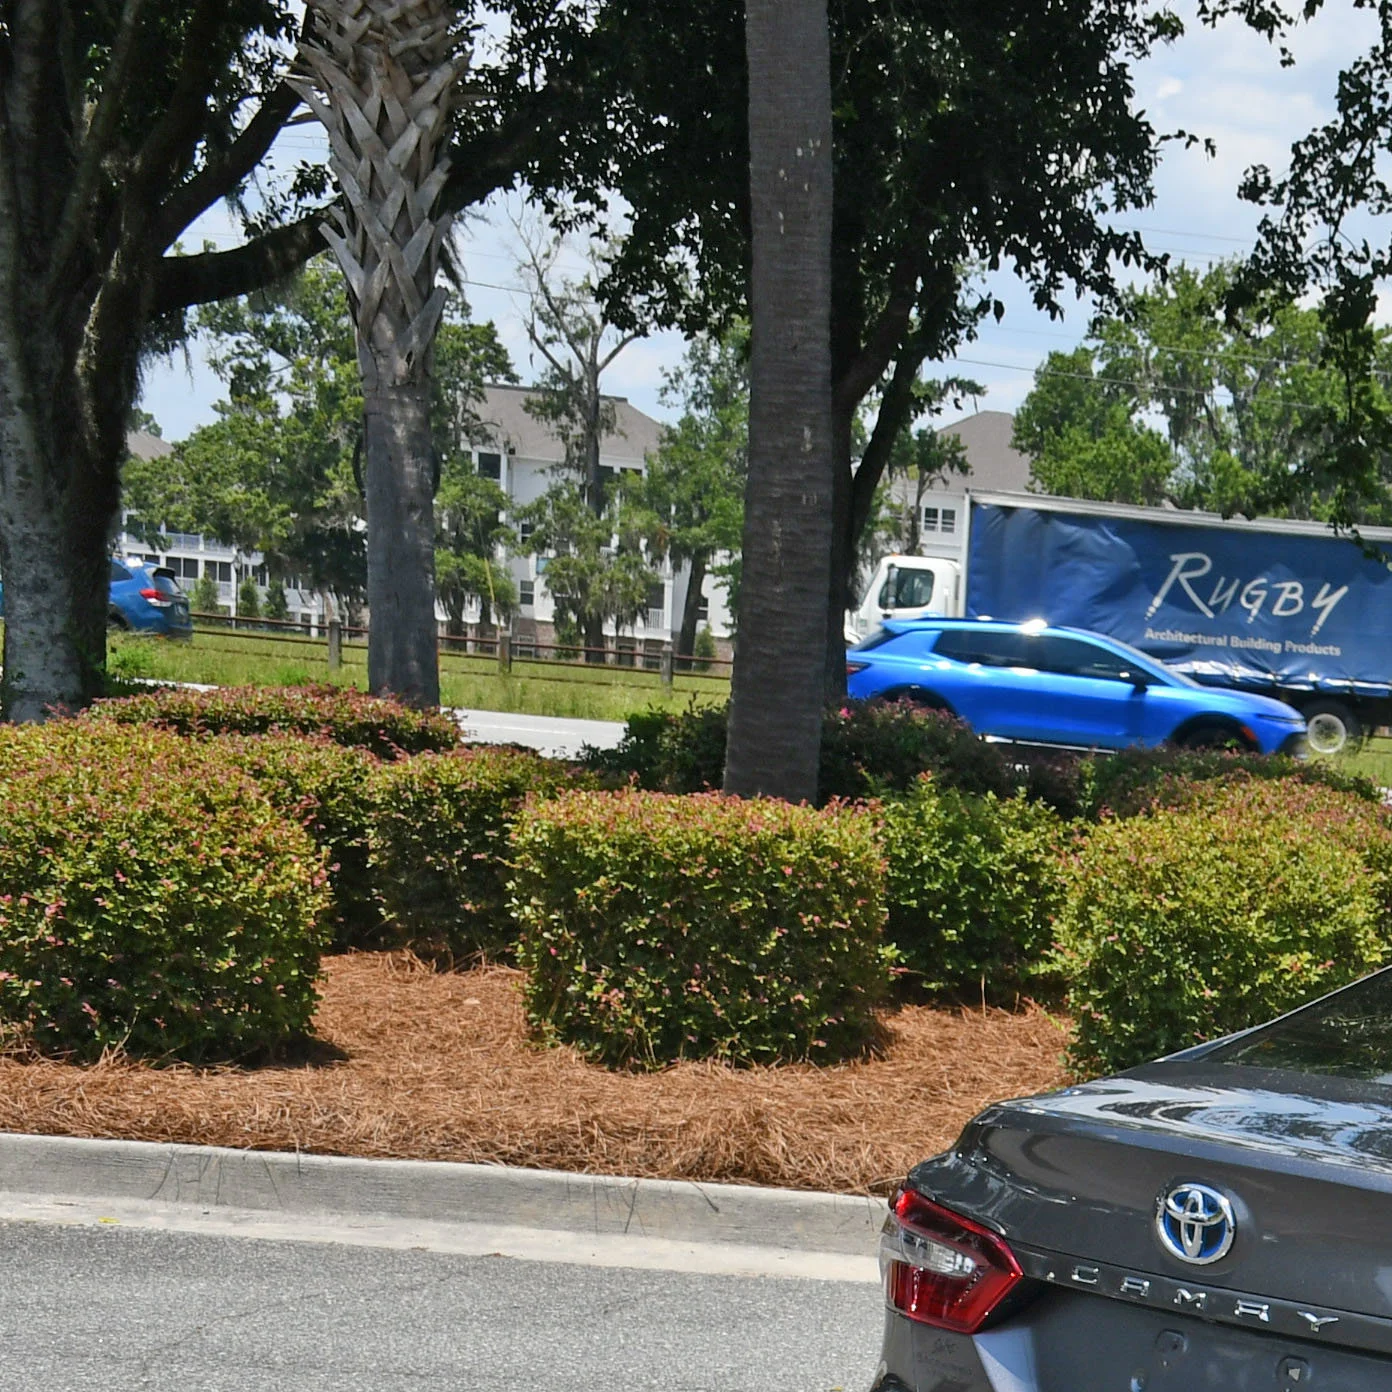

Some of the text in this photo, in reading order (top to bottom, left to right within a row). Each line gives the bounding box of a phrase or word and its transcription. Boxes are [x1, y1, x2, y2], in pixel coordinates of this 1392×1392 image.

[1144, 552, 1349, 637] RUGBY
[1144, 627, 1341, 656] Architectural Building Products
[1071, 1265, 1339, 1332] CAMRY
